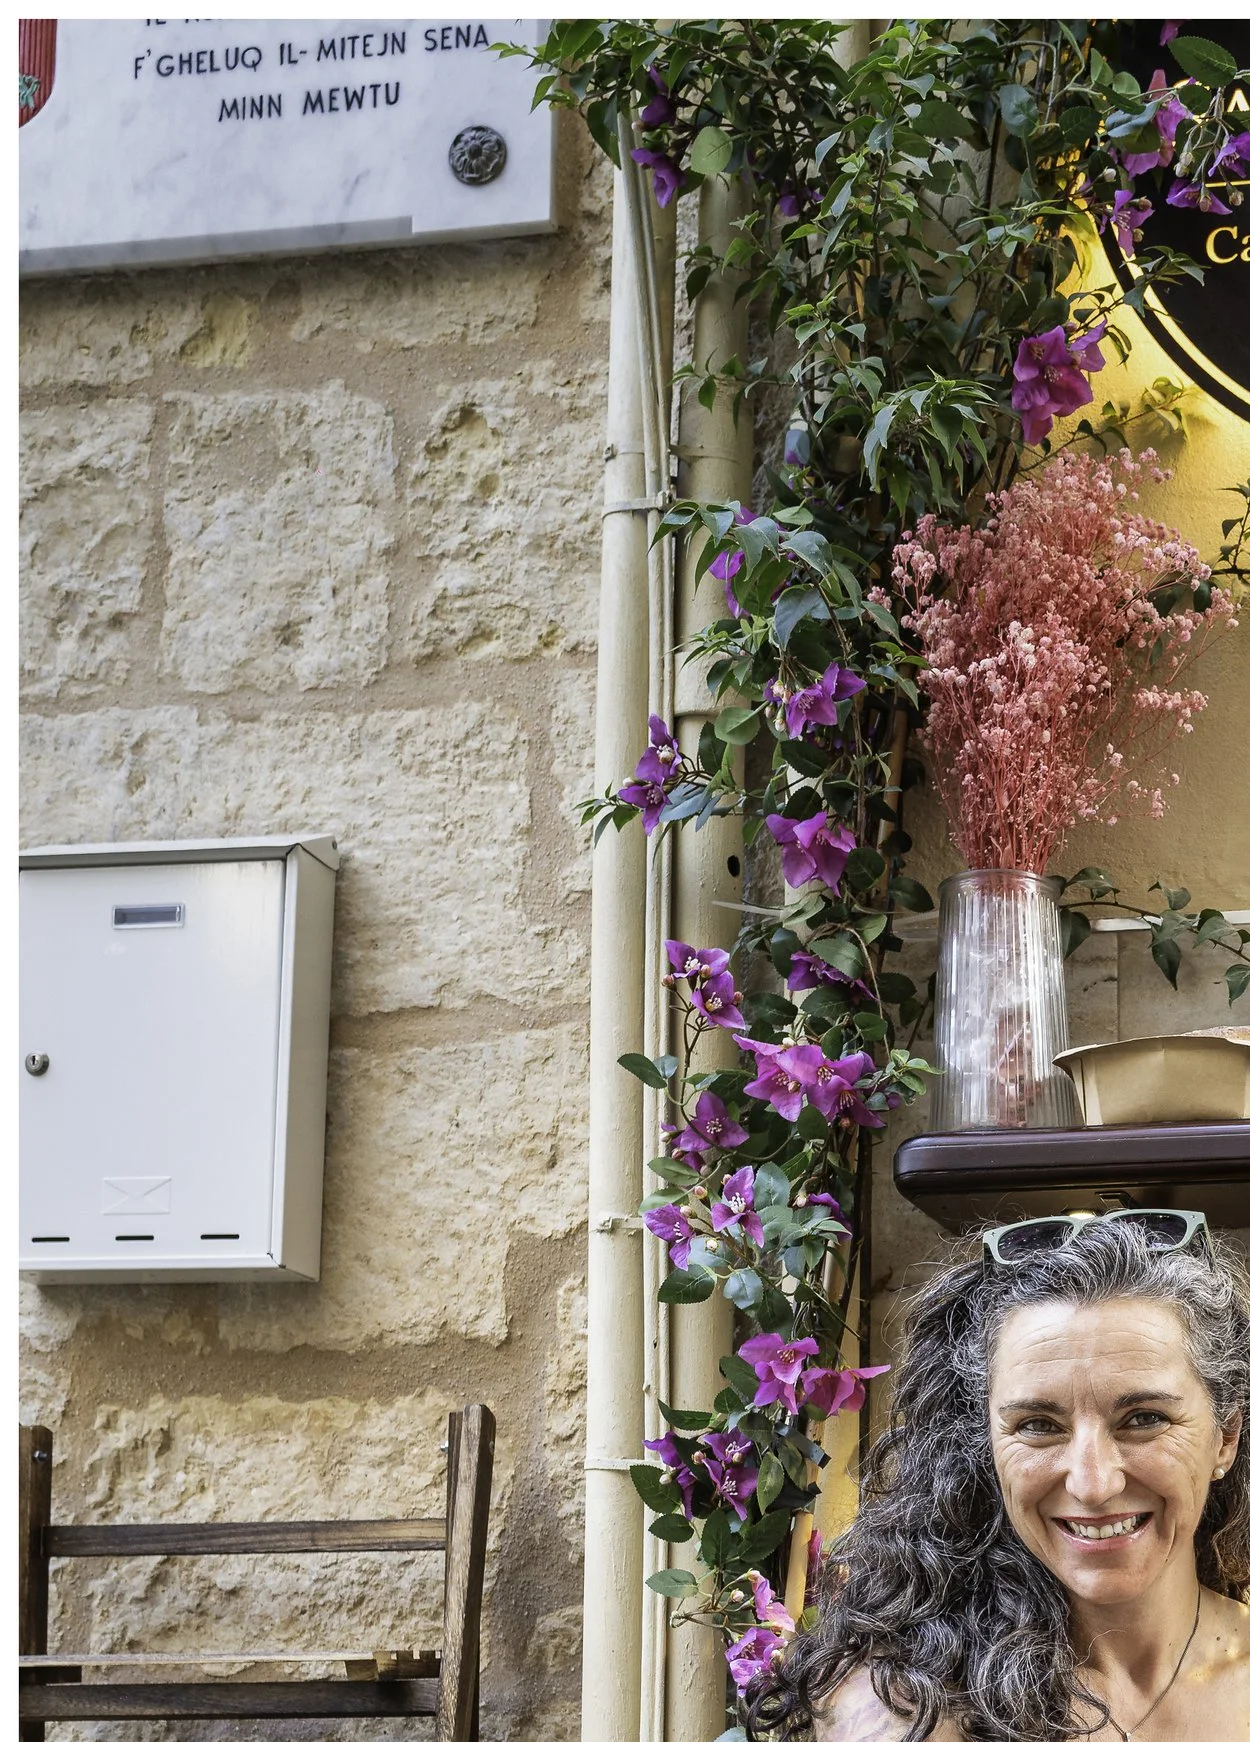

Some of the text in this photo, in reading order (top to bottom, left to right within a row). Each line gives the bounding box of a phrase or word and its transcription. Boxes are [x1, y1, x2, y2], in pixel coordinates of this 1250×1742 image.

[424, 24, 490, 52] SENA
[218, 82, 400, 122] MINN MEWTU
